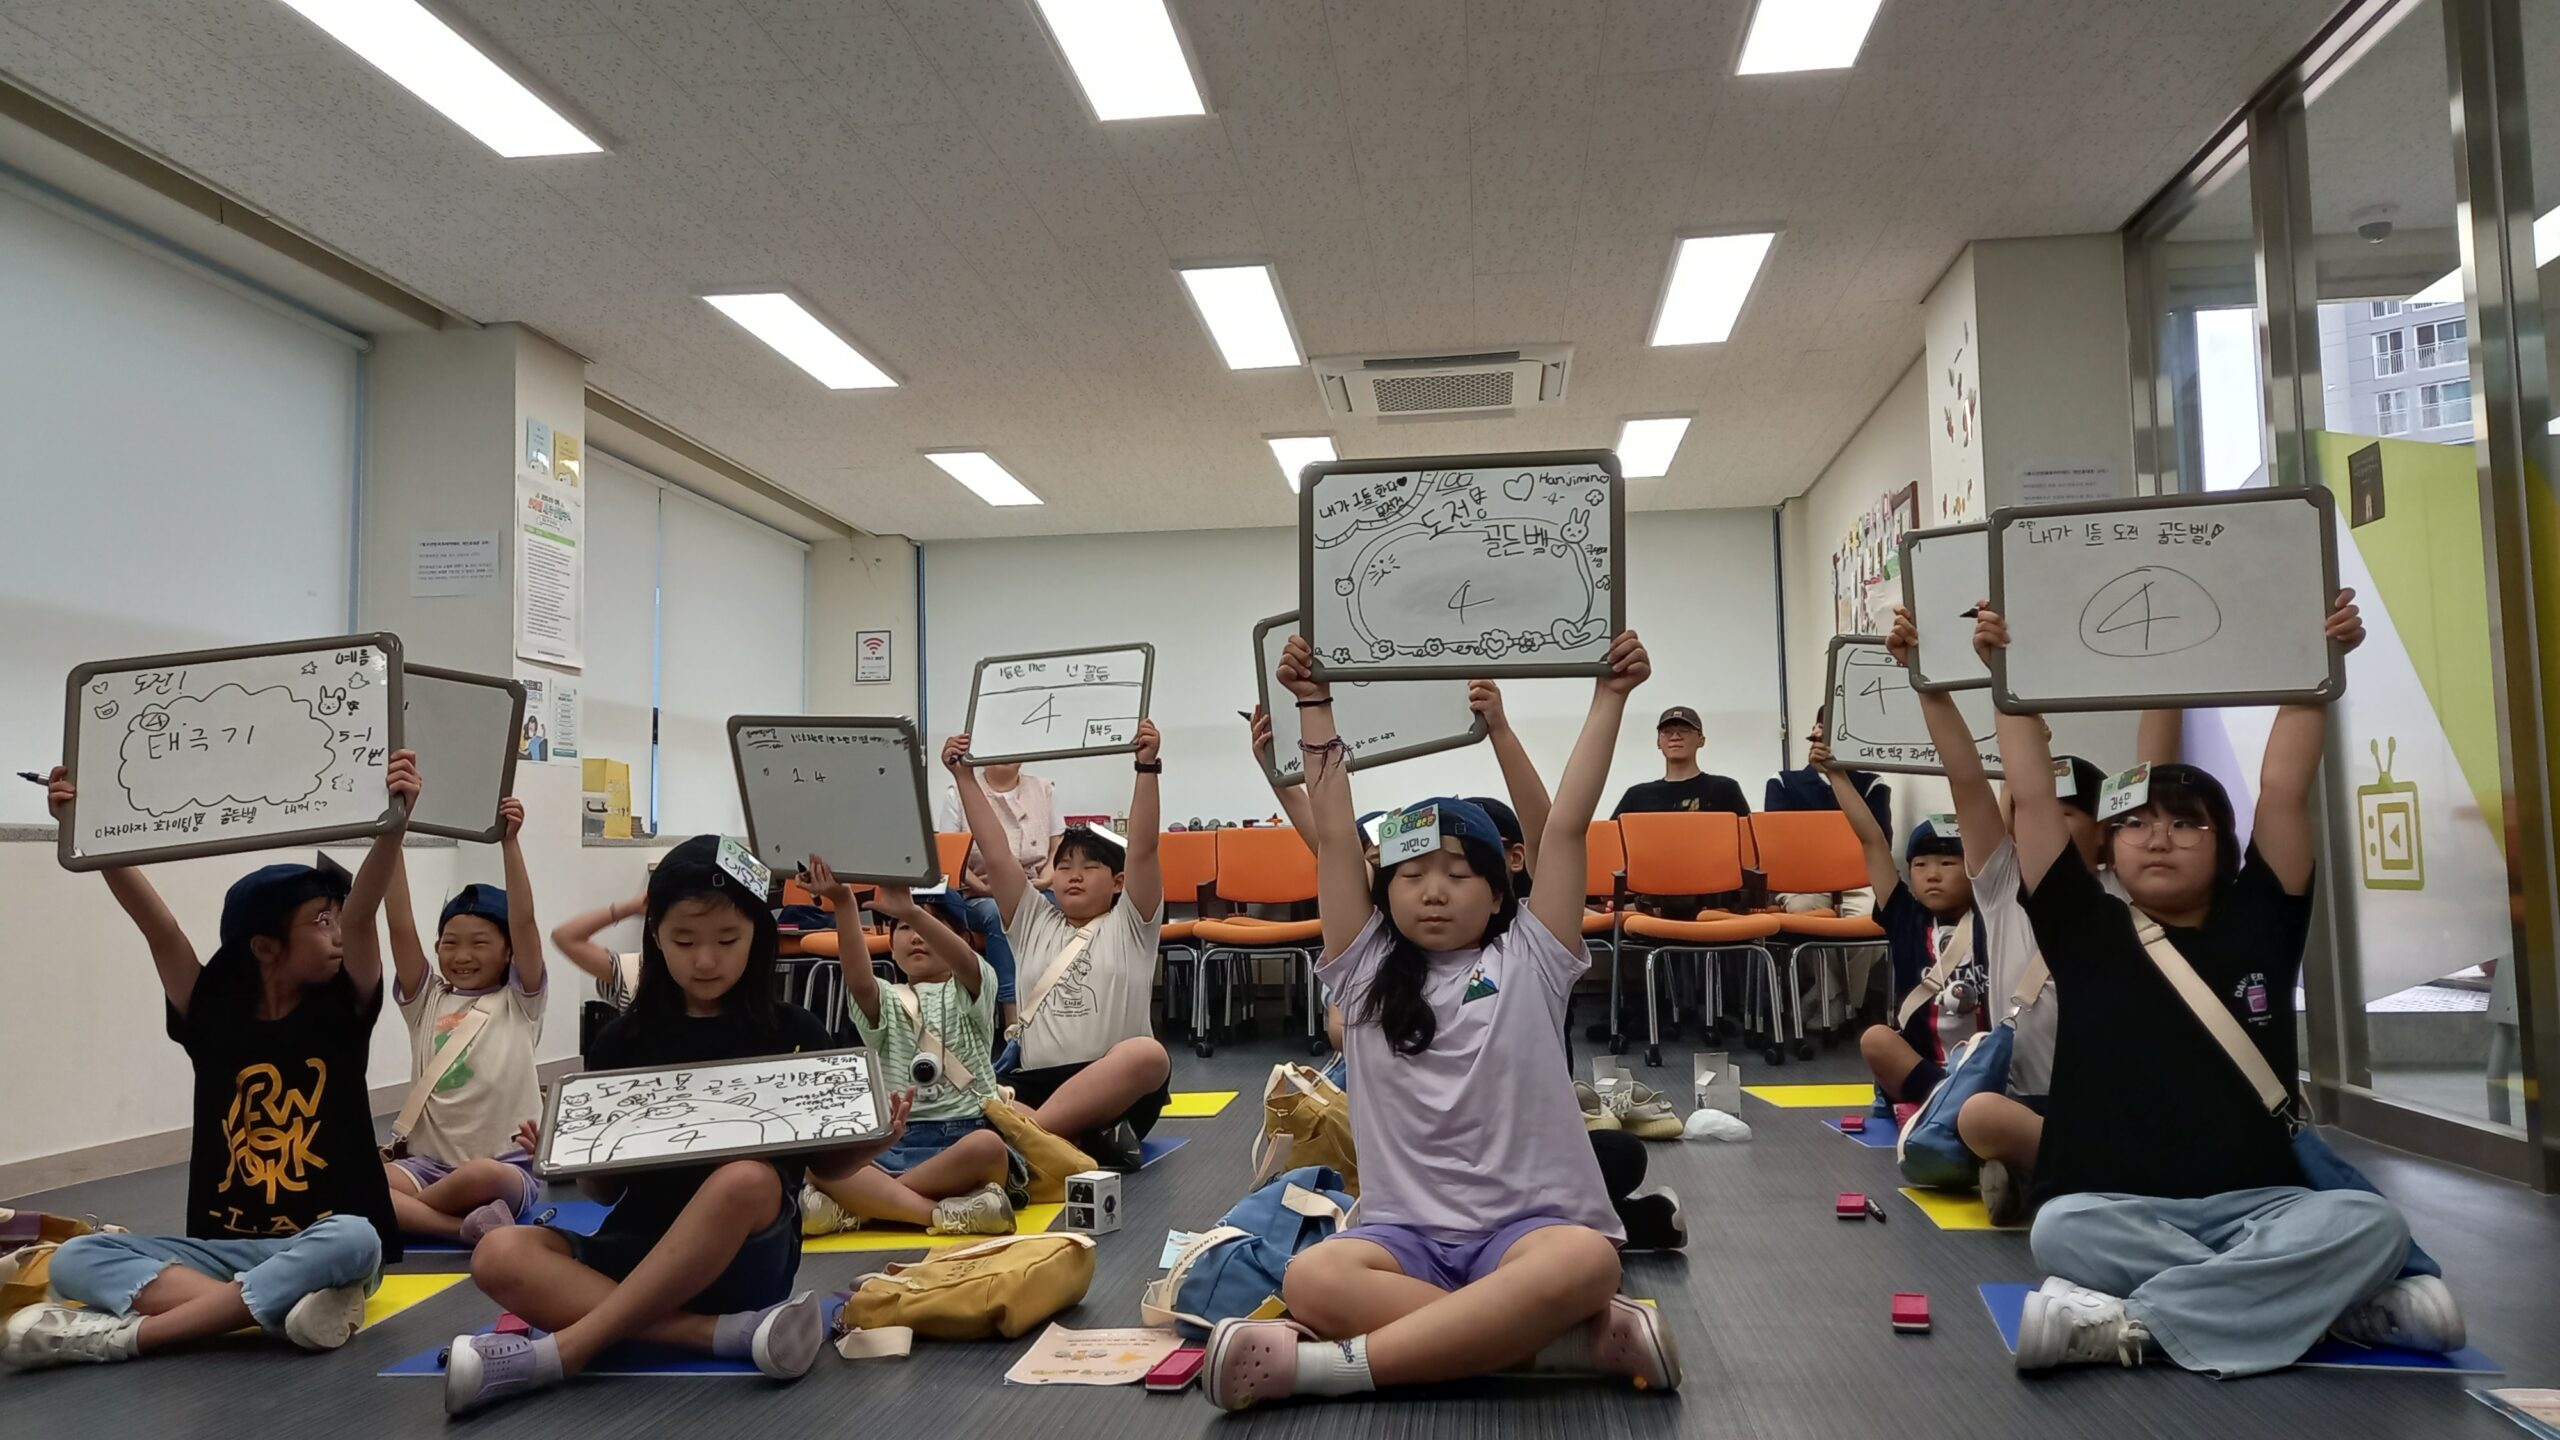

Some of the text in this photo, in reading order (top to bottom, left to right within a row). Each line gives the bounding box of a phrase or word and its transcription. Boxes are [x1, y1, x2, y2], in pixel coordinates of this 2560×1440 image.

[1319, 480, 1398, 518] 내가 1등 한다
[1482, 524, 1549, 558] 골든벨
[2030, 525, 2073, 545] 내가
[2113, 523, 2139, 541] 도전
[1448, 579, 1495, 625] 4
[2097, 581, 2180, 650] 4
[133, 670, 187, 695] 도전!
[1860, 676, 1909, 715] 4
[1022, 692, 1062, 734] 4
[95, 821, 148, 839] 아자아자
[220, 806, 257, 825] 골든벨
[1400, 837, 1420, 853] 지민
